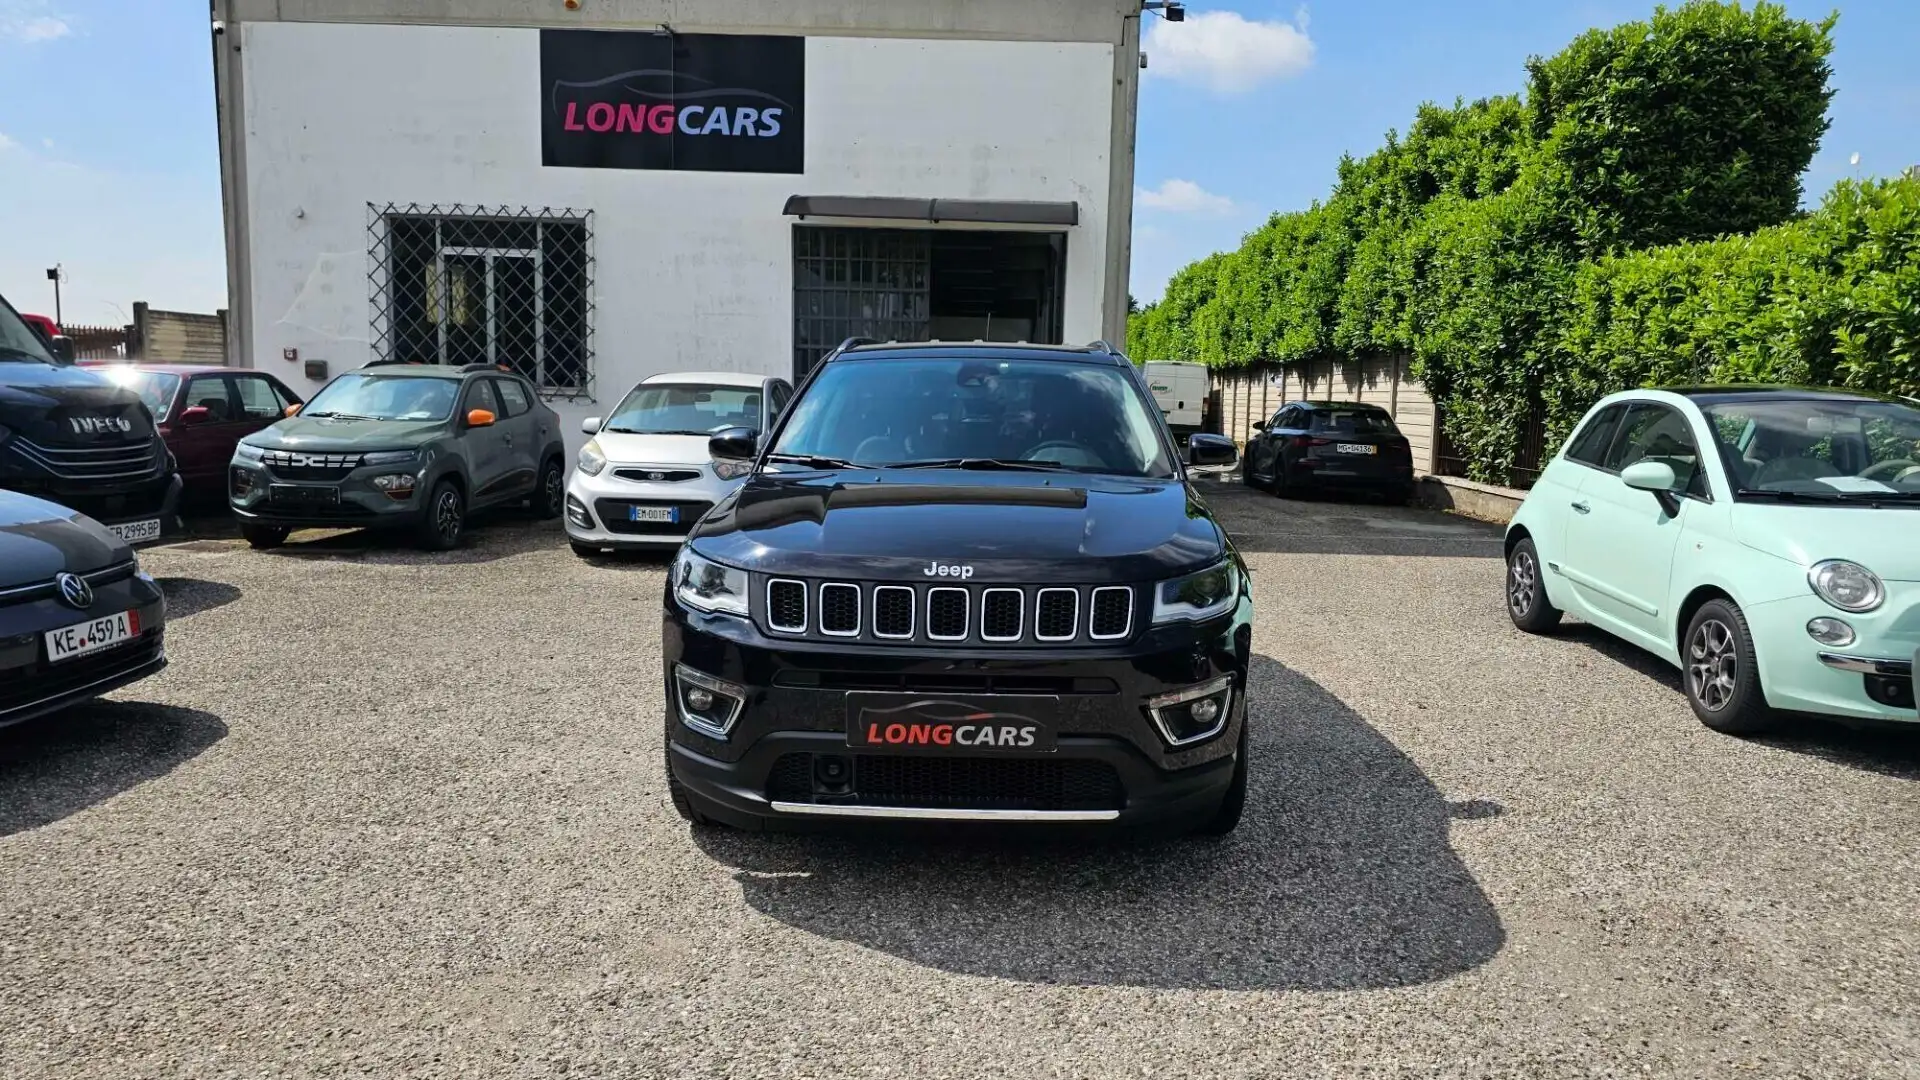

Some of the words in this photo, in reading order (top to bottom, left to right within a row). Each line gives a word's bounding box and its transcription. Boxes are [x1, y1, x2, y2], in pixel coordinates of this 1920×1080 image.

[564, 102, 783, 137] LONGCARS
[69, 417, 131, 434] IVECO
[923, 561, 973, 580] Jeep
[117, 616, 127, 638] A
[867, 723, 1037, 747] LONGCARS
